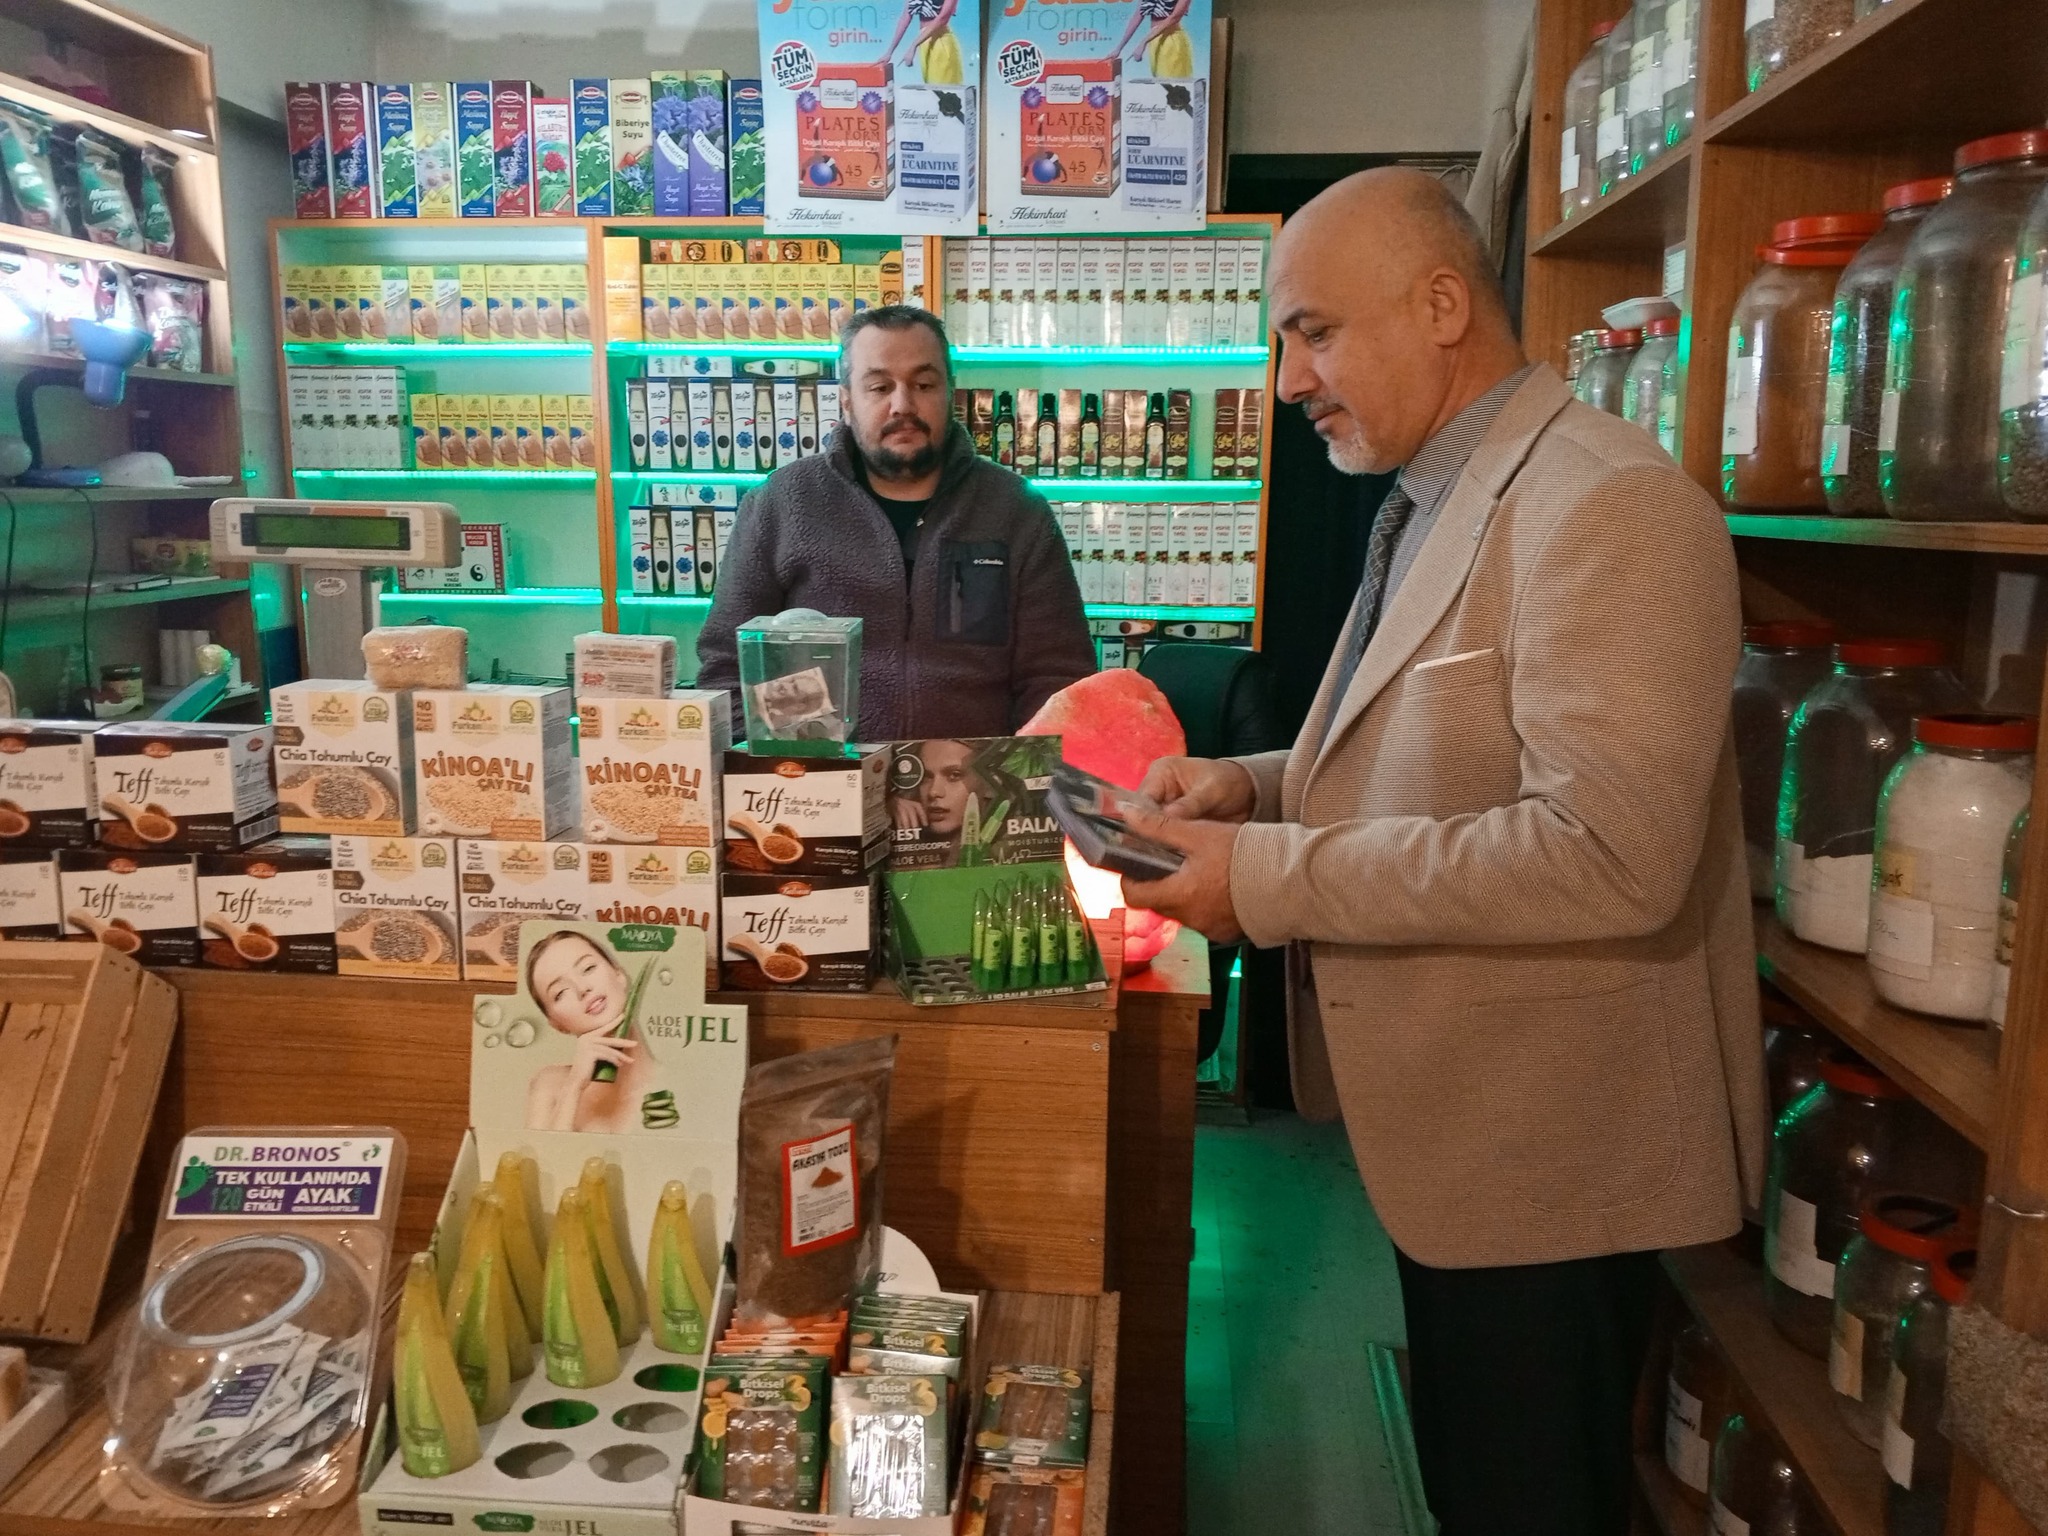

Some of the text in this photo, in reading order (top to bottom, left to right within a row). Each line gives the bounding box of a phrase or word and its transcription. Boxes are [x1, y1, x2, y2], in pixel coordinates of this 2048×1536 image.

[829, 28, 882, 47] girin...
[1058, 28, 1112, 46] girin...
[772, 45, 809, 71] TÜM
[1000, 43, 1036, 68] TÜM
[777, 63, 812, 82] SEÇKİN
[1003, 60, 1040, 77] SEÇKİN
[615, 119, 650, 129] Biberiye
[1069, 126, 1105, 135] FORM
[622, 130, 643, 139] Suyu
[845, 131, 881, 141] FORM
[901, 159, 959, 171] L'CARNITINE
[1069, 160, 1086, 173] 45
[1127, 154, 1186, 166] L'CARNITINE
[845, 165, 863, 177] 45
[947, 179, 960, 187] 420
[1174, 174, 1187, 182] 420
[787, 207, 845, 220] Hekimhan
[1009, 206, 1068, 220] Hekimhan
[416, 701, 432, 711] 40
[581, 707, 597, 717] 40
[280, 747, 392, 766] Chia Tohumlu Çay
[421, 750, 535, 783] KİNOA'LI
[586, 756, 702, 789] KİNOA'LI
[846, 773, 857, 781] 60
[113, 767, 153, 804] Teff
[506, 779, 531, 795] TEA
[672, 786, 698, 802] TEA
[742, 786, 785, 824] Teff
[592, 852, 608, 862] 40
[918, 855, 942, 864] VERA
[854, 889, 865, 897] 60
[78, 883, 119, 919] Teff
[216, 887, 257, 924] Teff
[339, 892, 449, 911] Chia Tohumlu Çay
[467, 895, 582, 915] Chia Tohumlu Çay
[595, 900, 710, 932] KİNOA'LI
[742, 906, 790, 944] Teff
[648, 1015, 682, 1028] ALOE
[648, 1026, 682, 1039] VERA
[682, 1015, 739, 1048] JEL
[215, 1170, 371, 1186] TEK KULLANIMDA
[246, 1186, 285, 1200] GÜN
[293, 1188, 354, 1204] AYAK
[679, 1322, 700, 1334] JEL
[882, 1334, 925, 1348] Bitkisel
[561, 1359, 581, 1372] JEL
[739, 1377, 785, 1390] Bitkisel
[866, 1383, 911, 1394] Bitkisel
[743, 1388, 781, 1400] Drops
[871, 1392, 907, 1404] Drops
[422, 1446, 445, 1458] JEL
[564, 1519, 603, 1536] JEL
